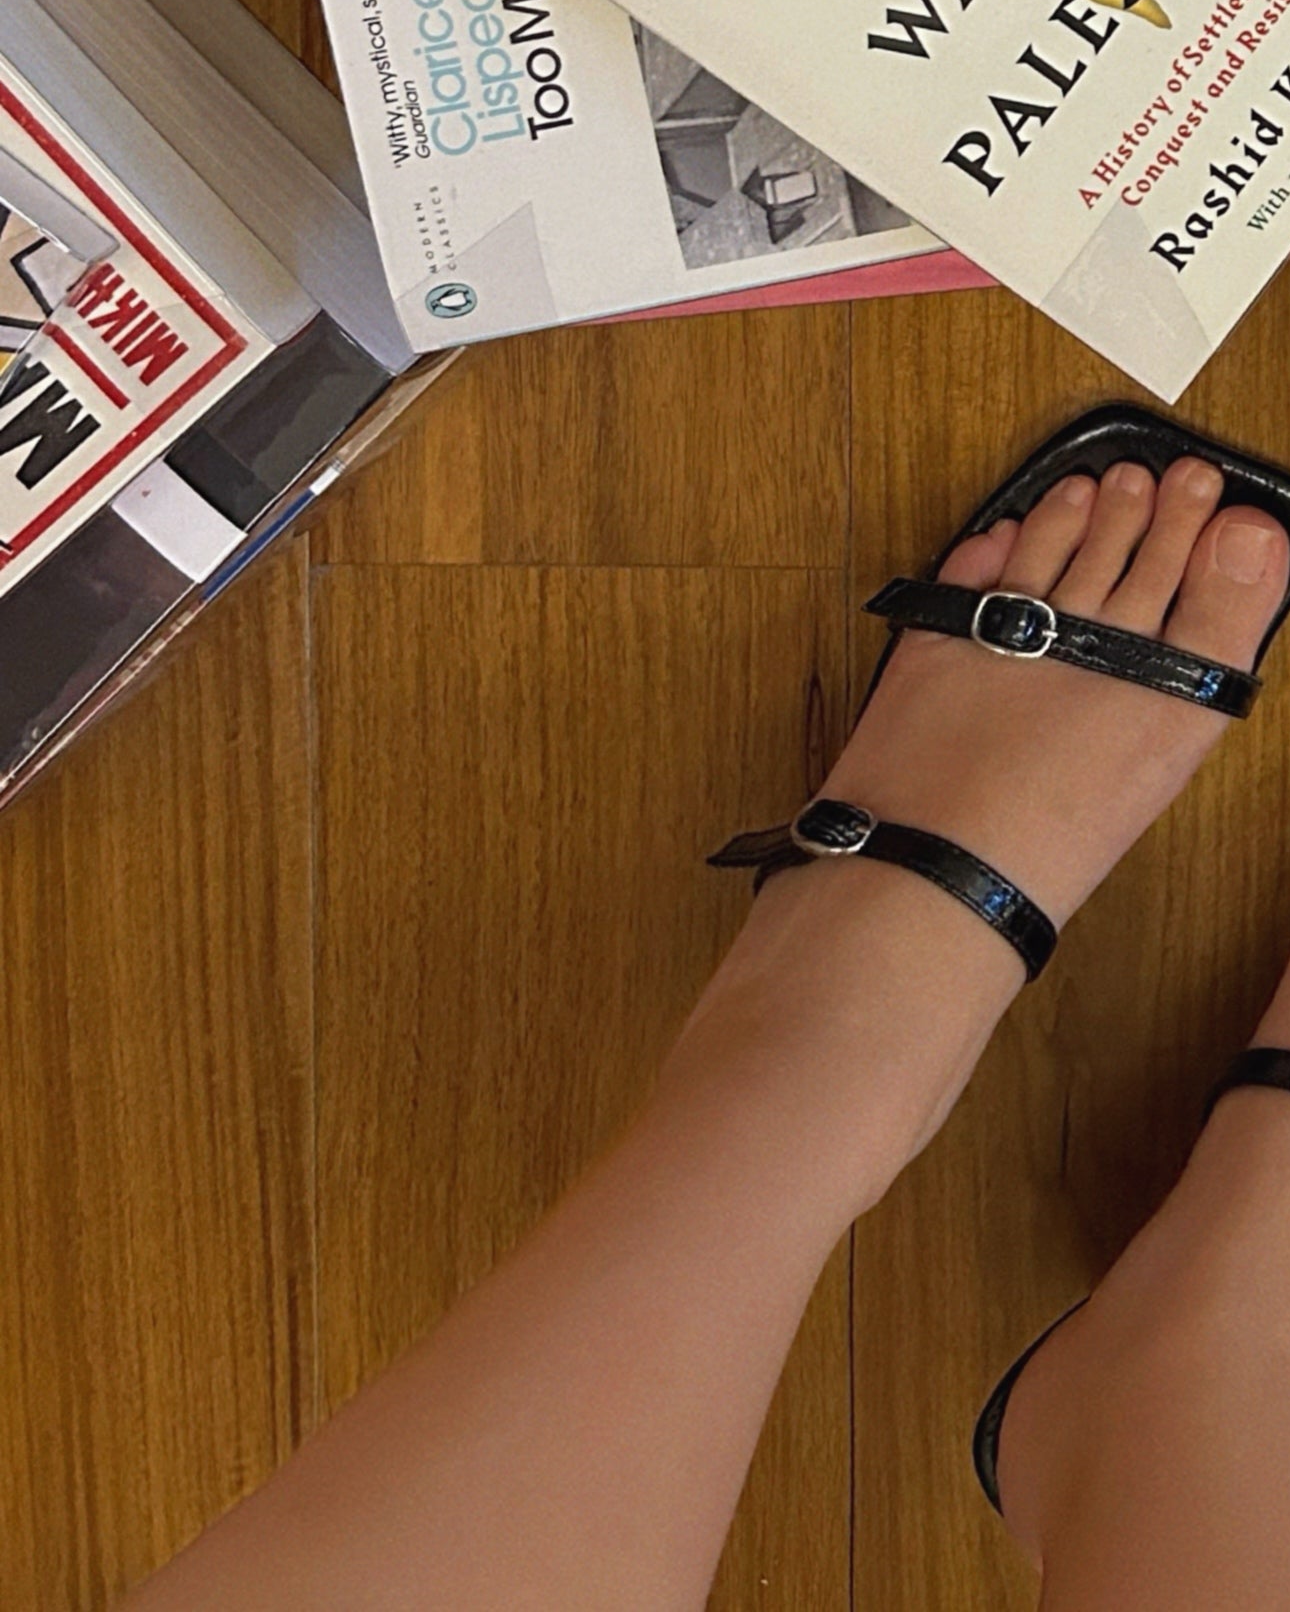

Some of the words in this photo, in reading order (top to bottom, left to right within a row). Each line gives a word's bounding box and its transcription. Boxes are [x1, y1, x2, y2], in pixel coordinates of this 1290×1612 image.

[362, 11, 397, 104] mystical,
[525, 47, 574, 141] Too
[403, 80, 431, 159] Guardian
[1077, 187, 1102, 210] A
[1092, 94, 1173, 186] History
[1166, 58, 1192, 93] of
[1120, 98, 1209, 207] Conquest
[1206, 49, 1245, 99] and
[429, 186, 457, 271] CLASSICS
[1149, 107, 1284, 273] Rashid
[1246, 181, 1290, 233] With
[413, 203, 438, 274] MODERN
